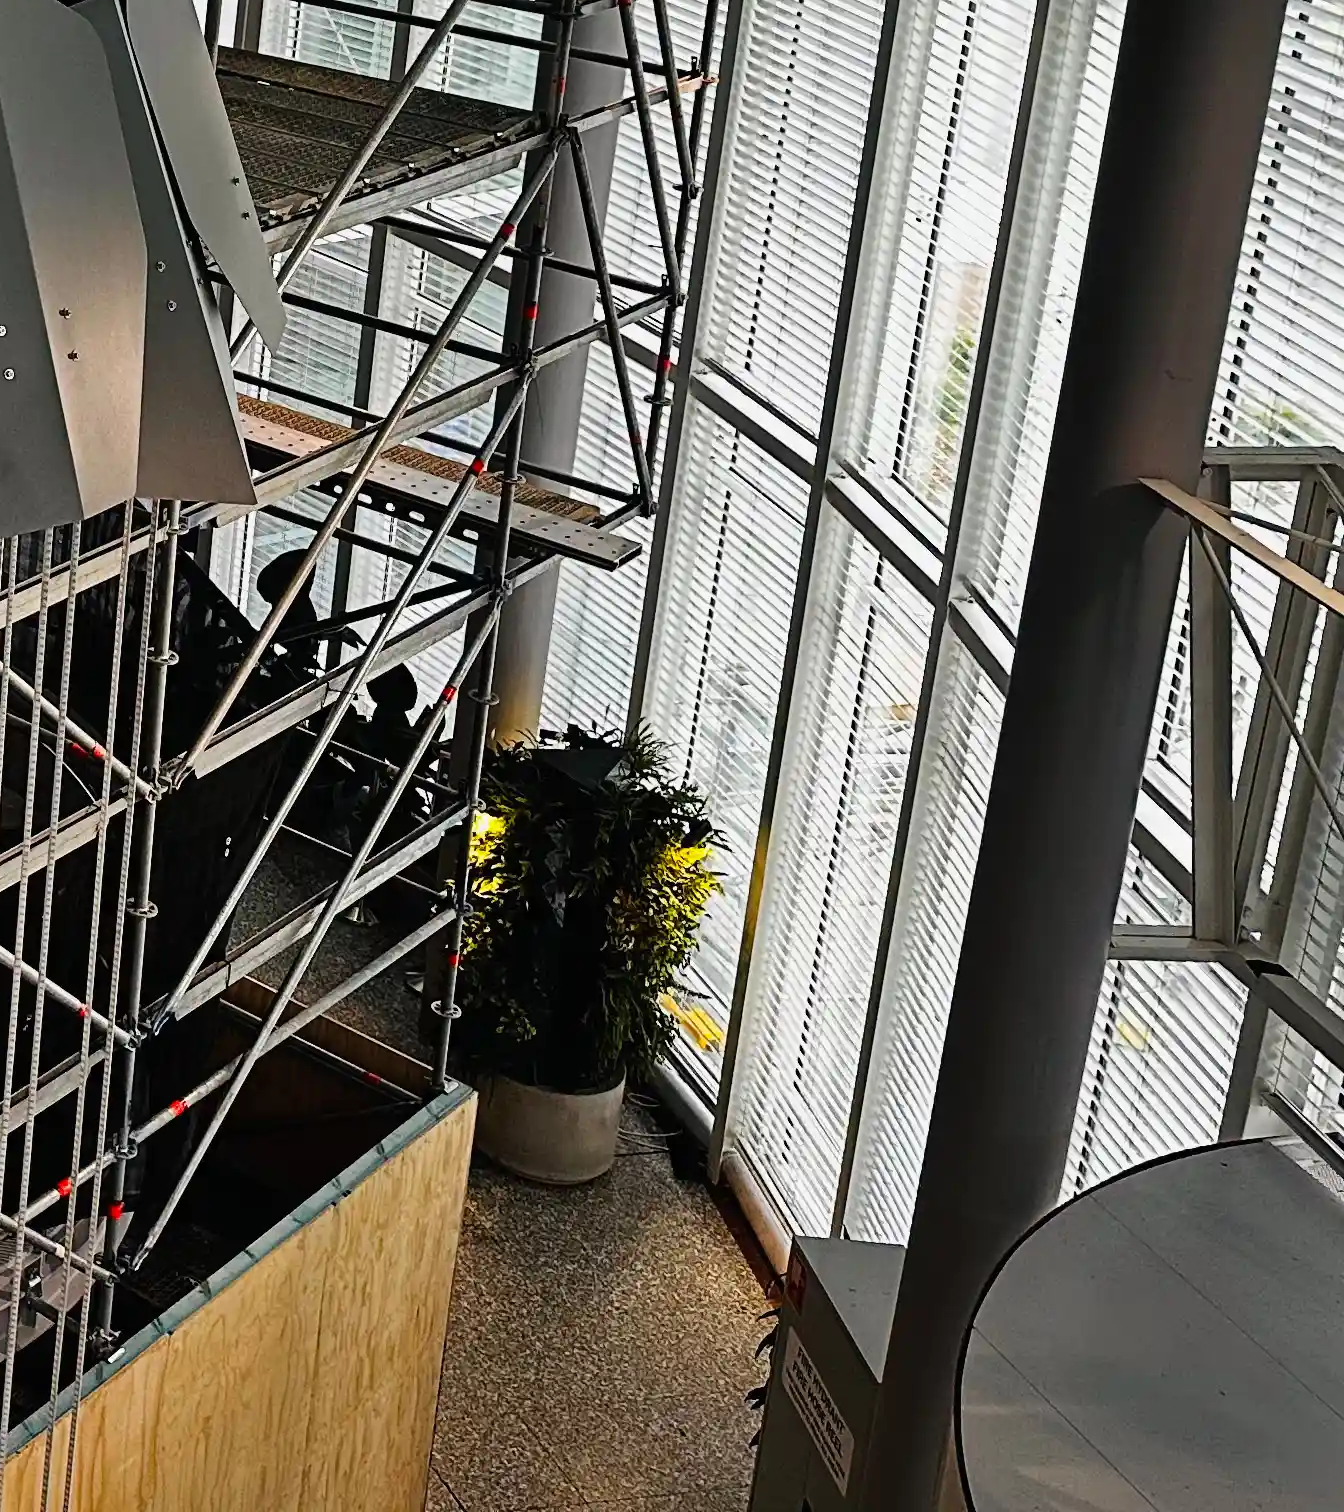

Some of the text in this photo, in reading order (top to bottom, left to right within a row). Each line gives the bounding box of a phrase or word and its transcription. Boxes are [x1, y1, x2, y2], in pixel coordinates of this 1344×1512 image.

[792, 1360, 844, 1458] FIRE HOSE REEL
[797, 1346, 813, 1379] FIRE
[812, 1374, 845, 1435] HYDRANT
